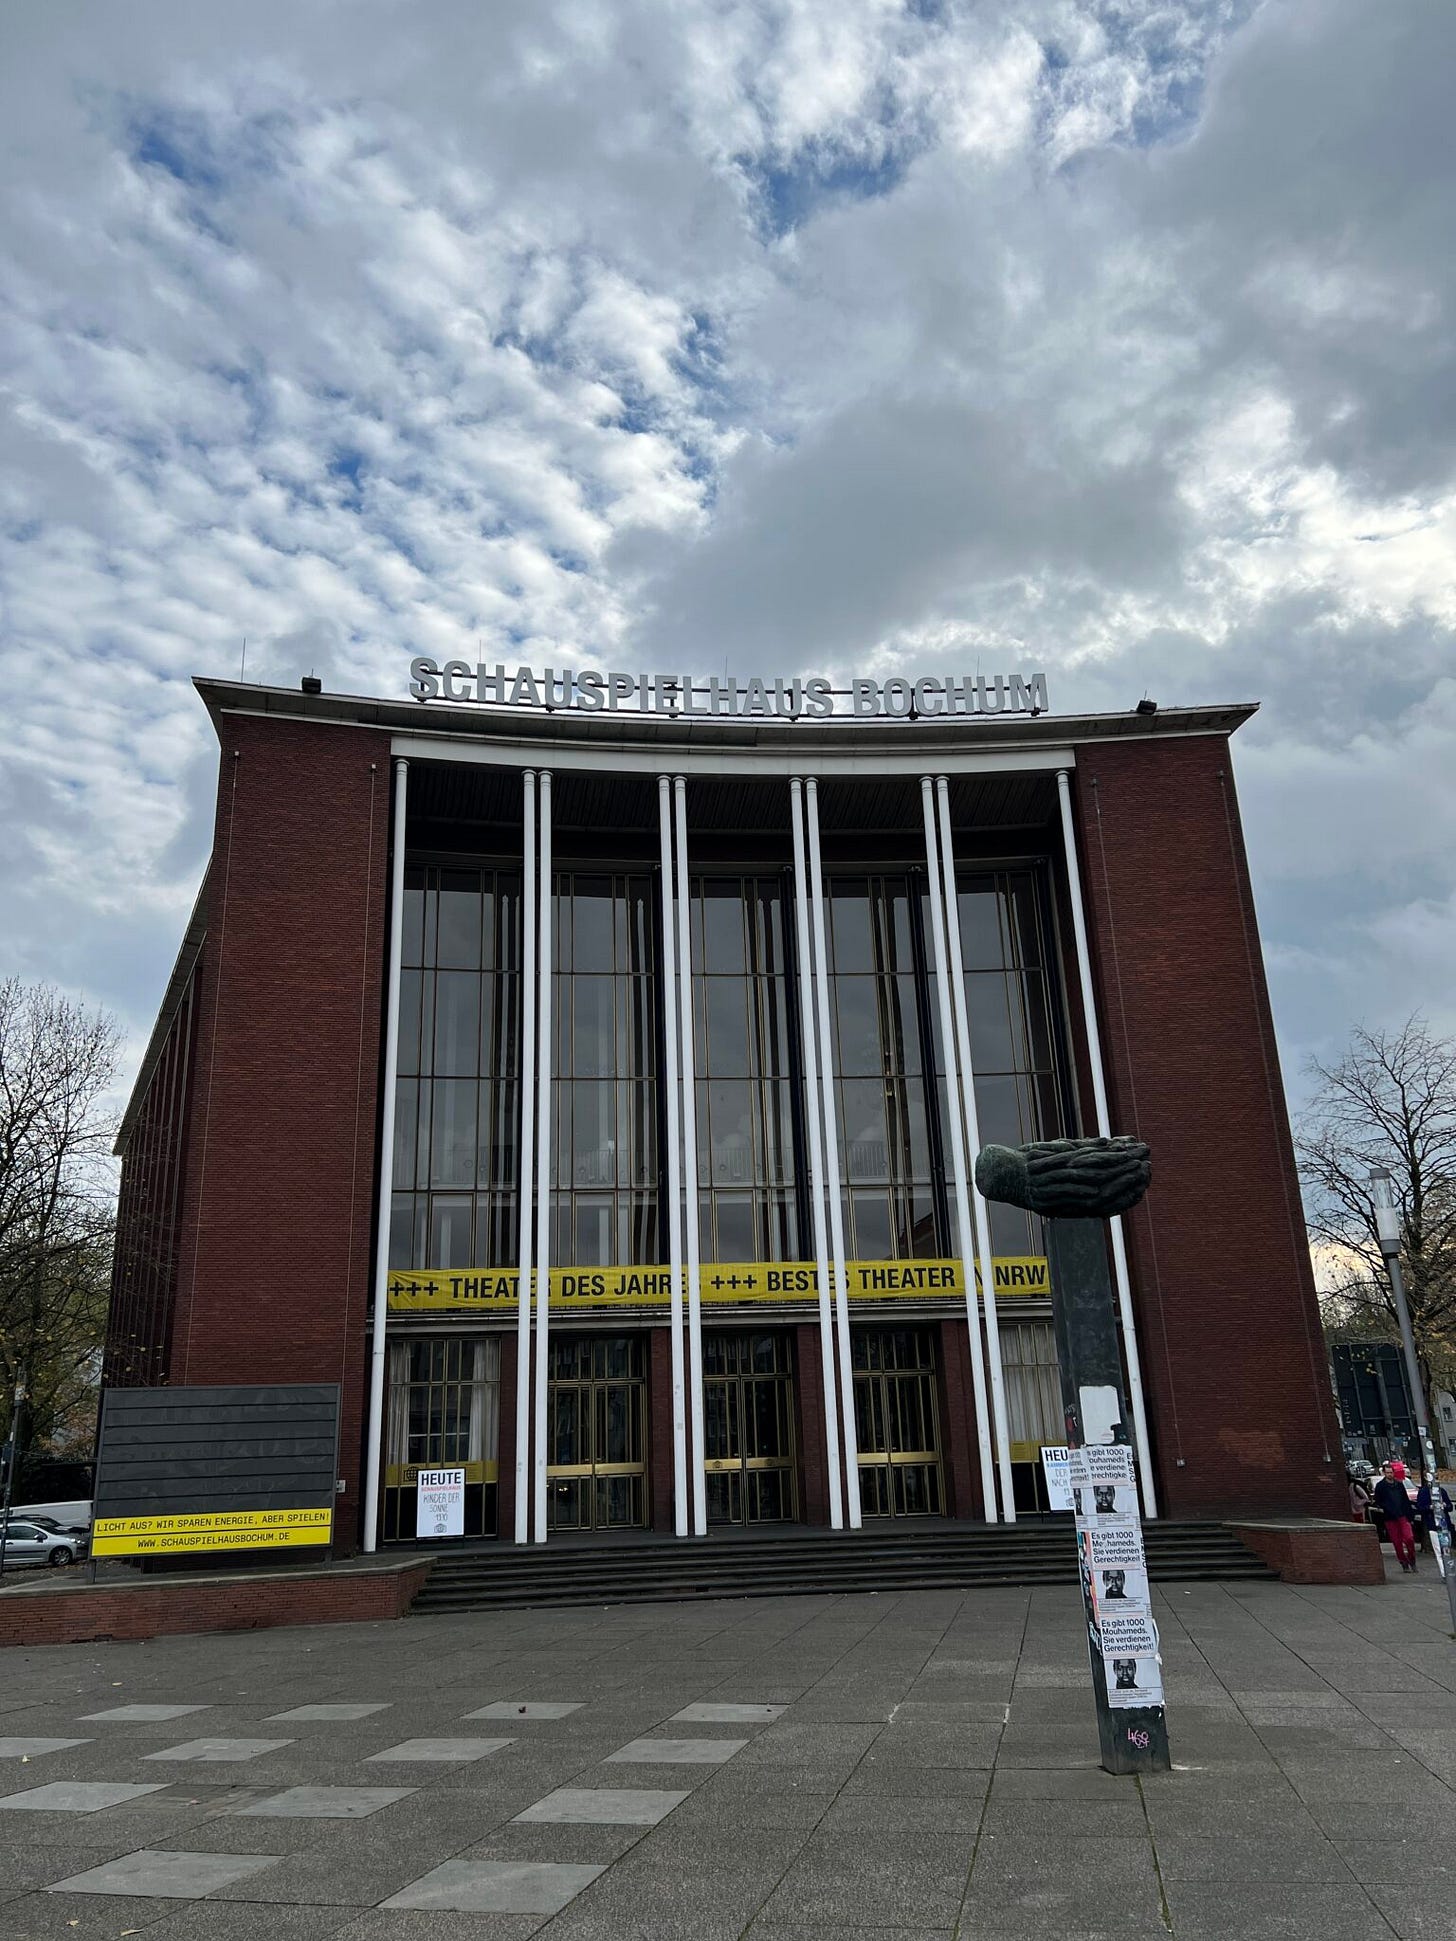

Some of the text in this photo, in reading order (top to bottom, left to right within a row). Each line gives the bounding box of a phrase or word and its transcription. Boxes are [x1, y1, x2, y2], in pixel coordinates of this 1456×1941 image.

[409, 657, 1049, 717] SCHAUSPIELHAUS BOCHUM
[562, 1275, 605, 1297] DES
[858, 1266, 955, 1290] THEATER
[995, 1265, 1046, 1286] NRW
[1045, 1449, 1068, 1462] HEU
[1089, 1456, 1126, 1464] ouhameds
[421, 1472, 462, 1486] HEUTE
[97, 1513, 329, 1532] LICHT AUS? WIR SPAREN ENERGIE, ABER SPIELEN!
[137, 1532, 290, 1548] WWW.SCHAUSPIELHAUSBOCHUM.DE
[1101, 1531, 1114, 1540] gibt
[1116, 1531, 1134, 1539] 1000
[1093, 1547, 1139, 1556] Sie verdienen
[1093, 1556, 1140, 1564] Gerechtigkeit
[1111, 1619, 1125, 1628] gibt
[1102, 1627, 1148, 1635] Mouhameds.
[1103, 1635, 1151, 1644] Sie verdienen
